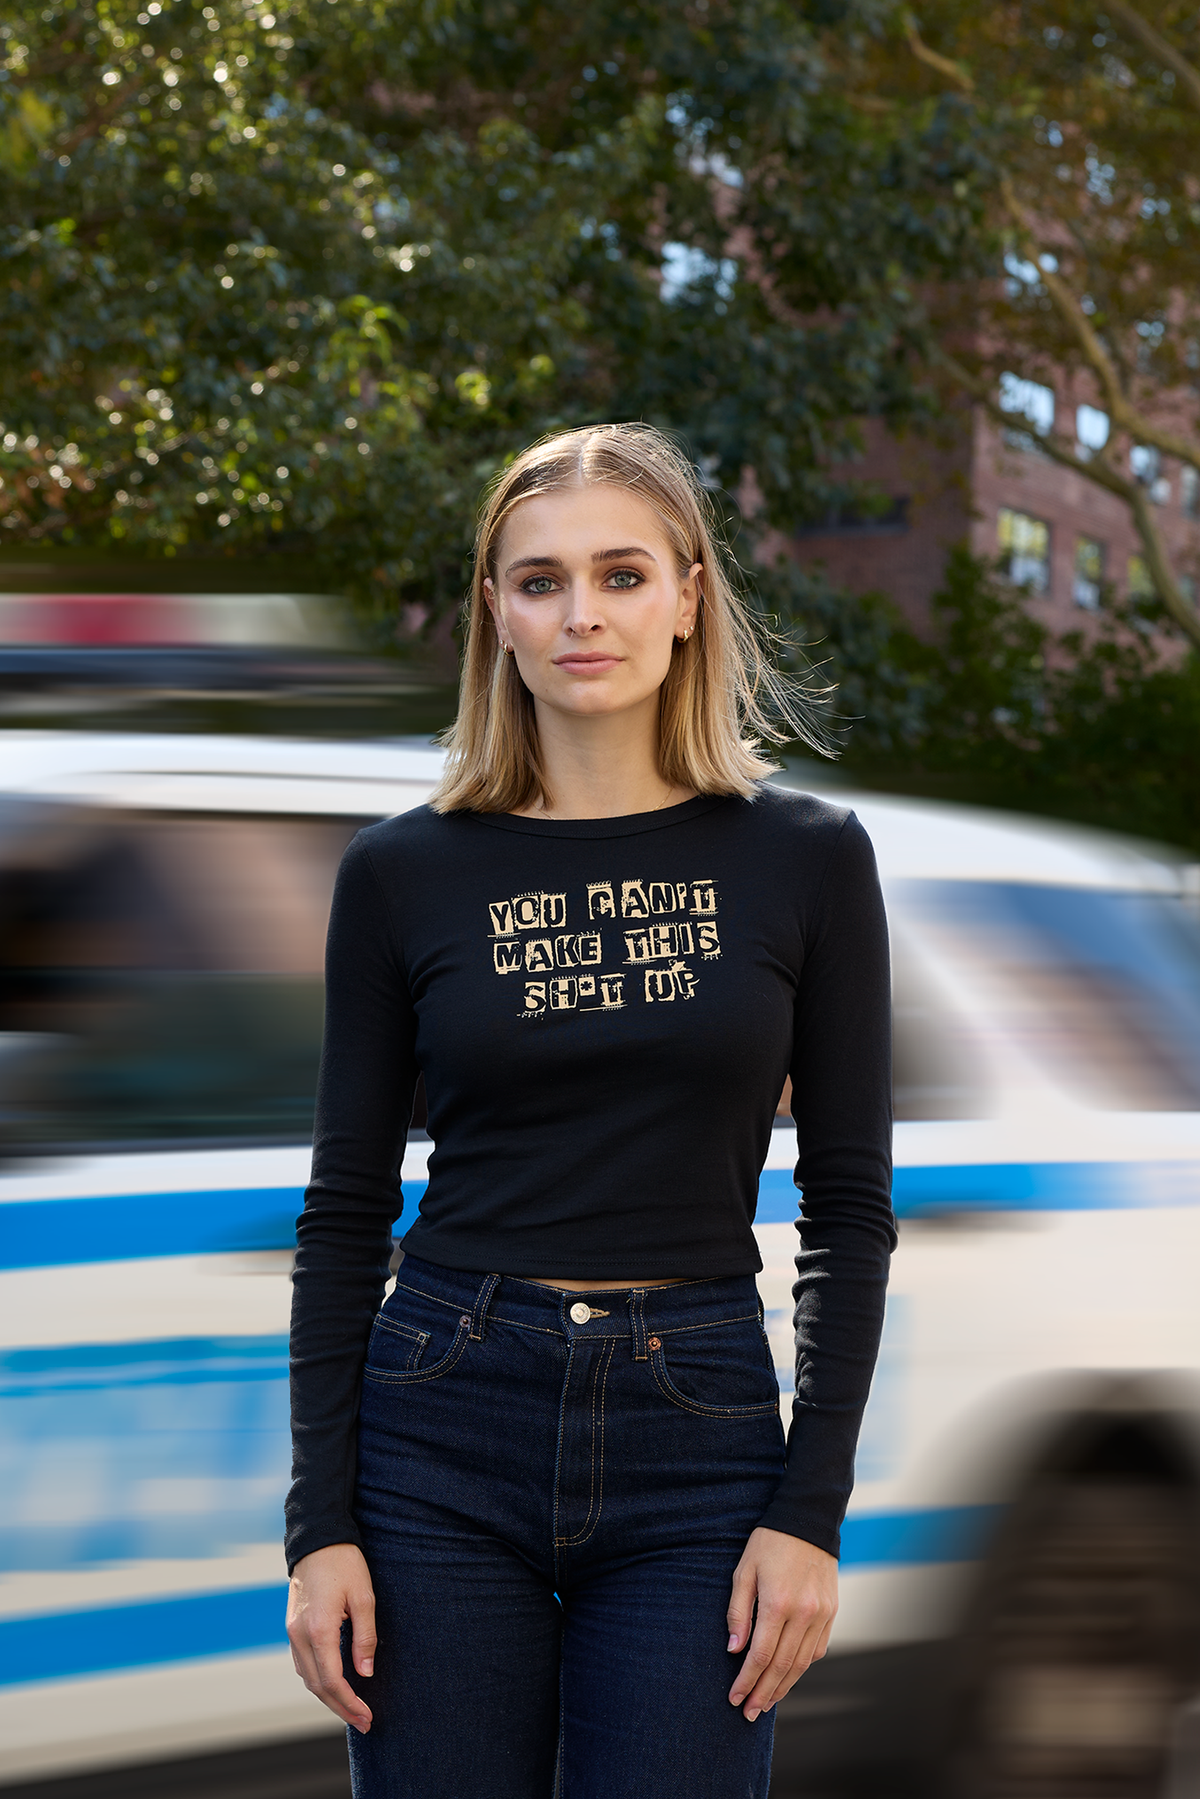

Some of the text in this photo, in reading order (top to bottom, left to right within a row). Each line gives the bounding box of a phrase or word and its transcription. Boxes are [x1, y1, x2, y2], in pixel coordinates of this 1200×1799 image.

[488, 879, 719, 937] YOU CAN'T
[493, 921, 723, 974] MAKE THIS
[645, 960, 700, 1002] UP
